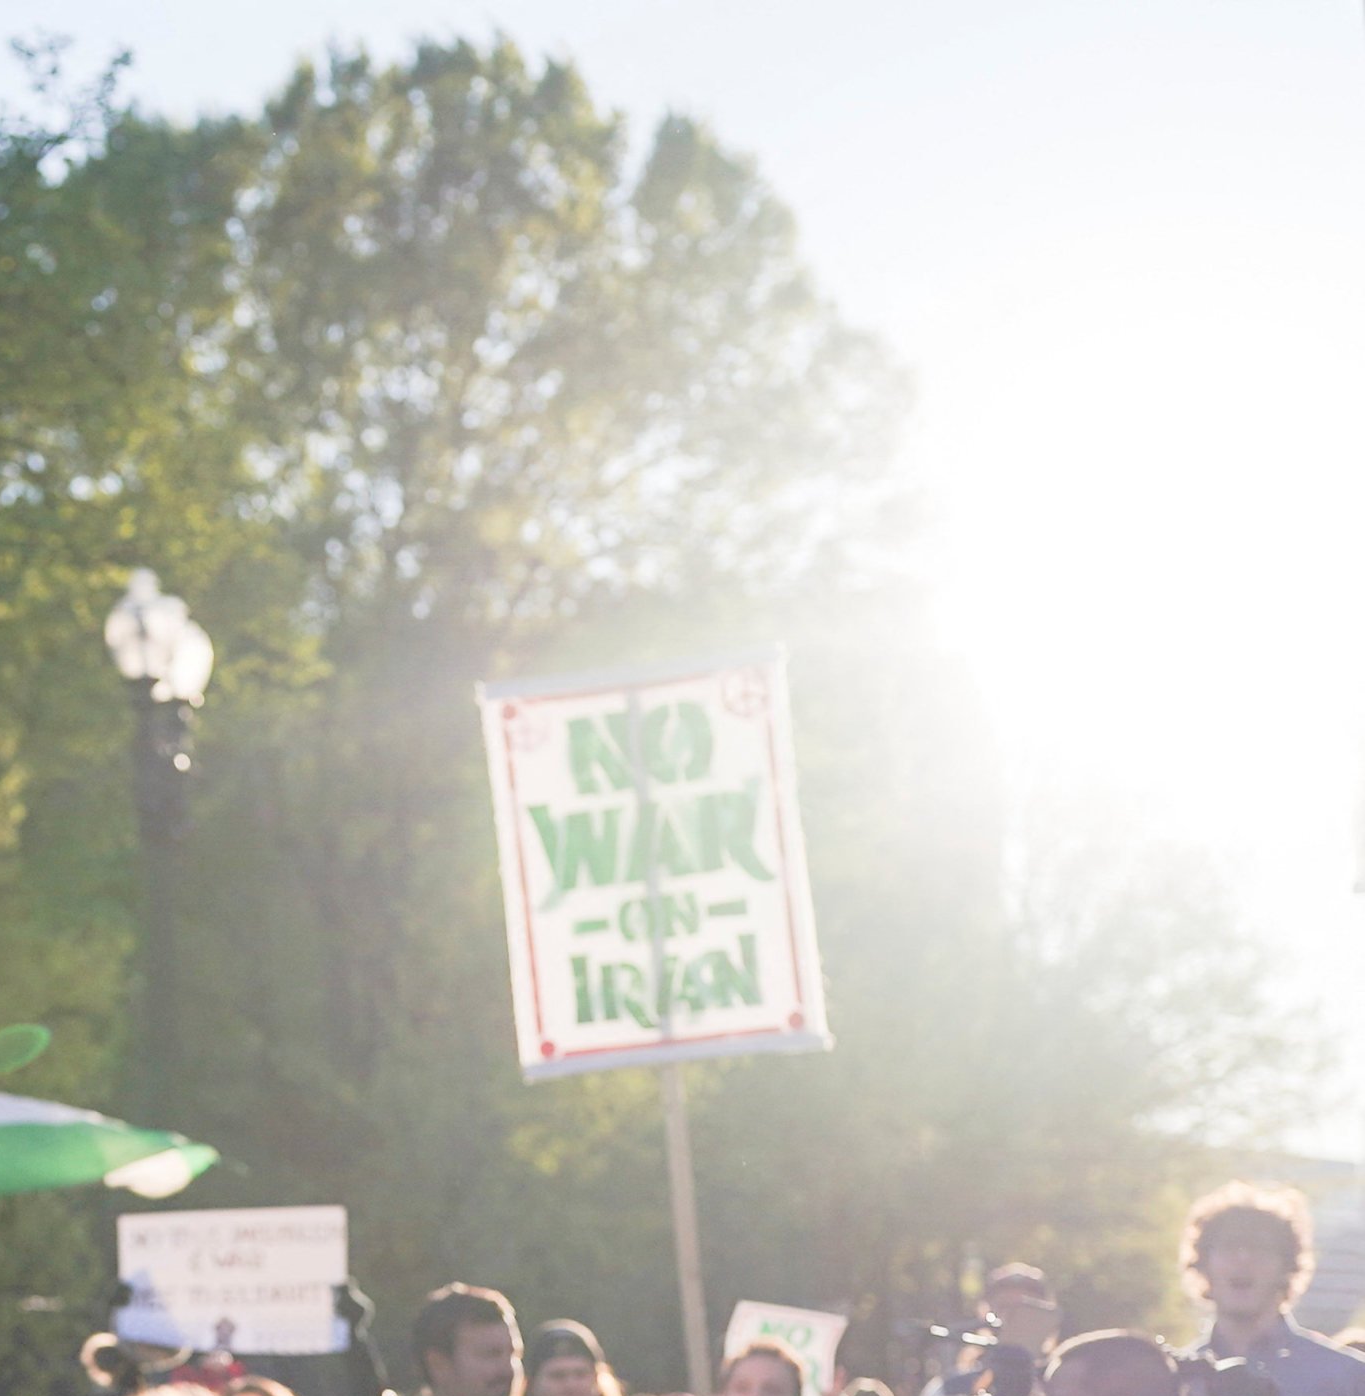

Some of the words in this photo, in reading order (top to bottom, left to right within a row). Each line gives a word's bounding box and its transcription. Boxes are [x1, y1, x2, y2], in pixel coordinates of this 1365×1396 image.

[567, 701, 714, 794] NO
[527, 775, 776, 912] WAR
[618, 890, 701, 942] ON
[570, 934, 764, 1030] IRAN
